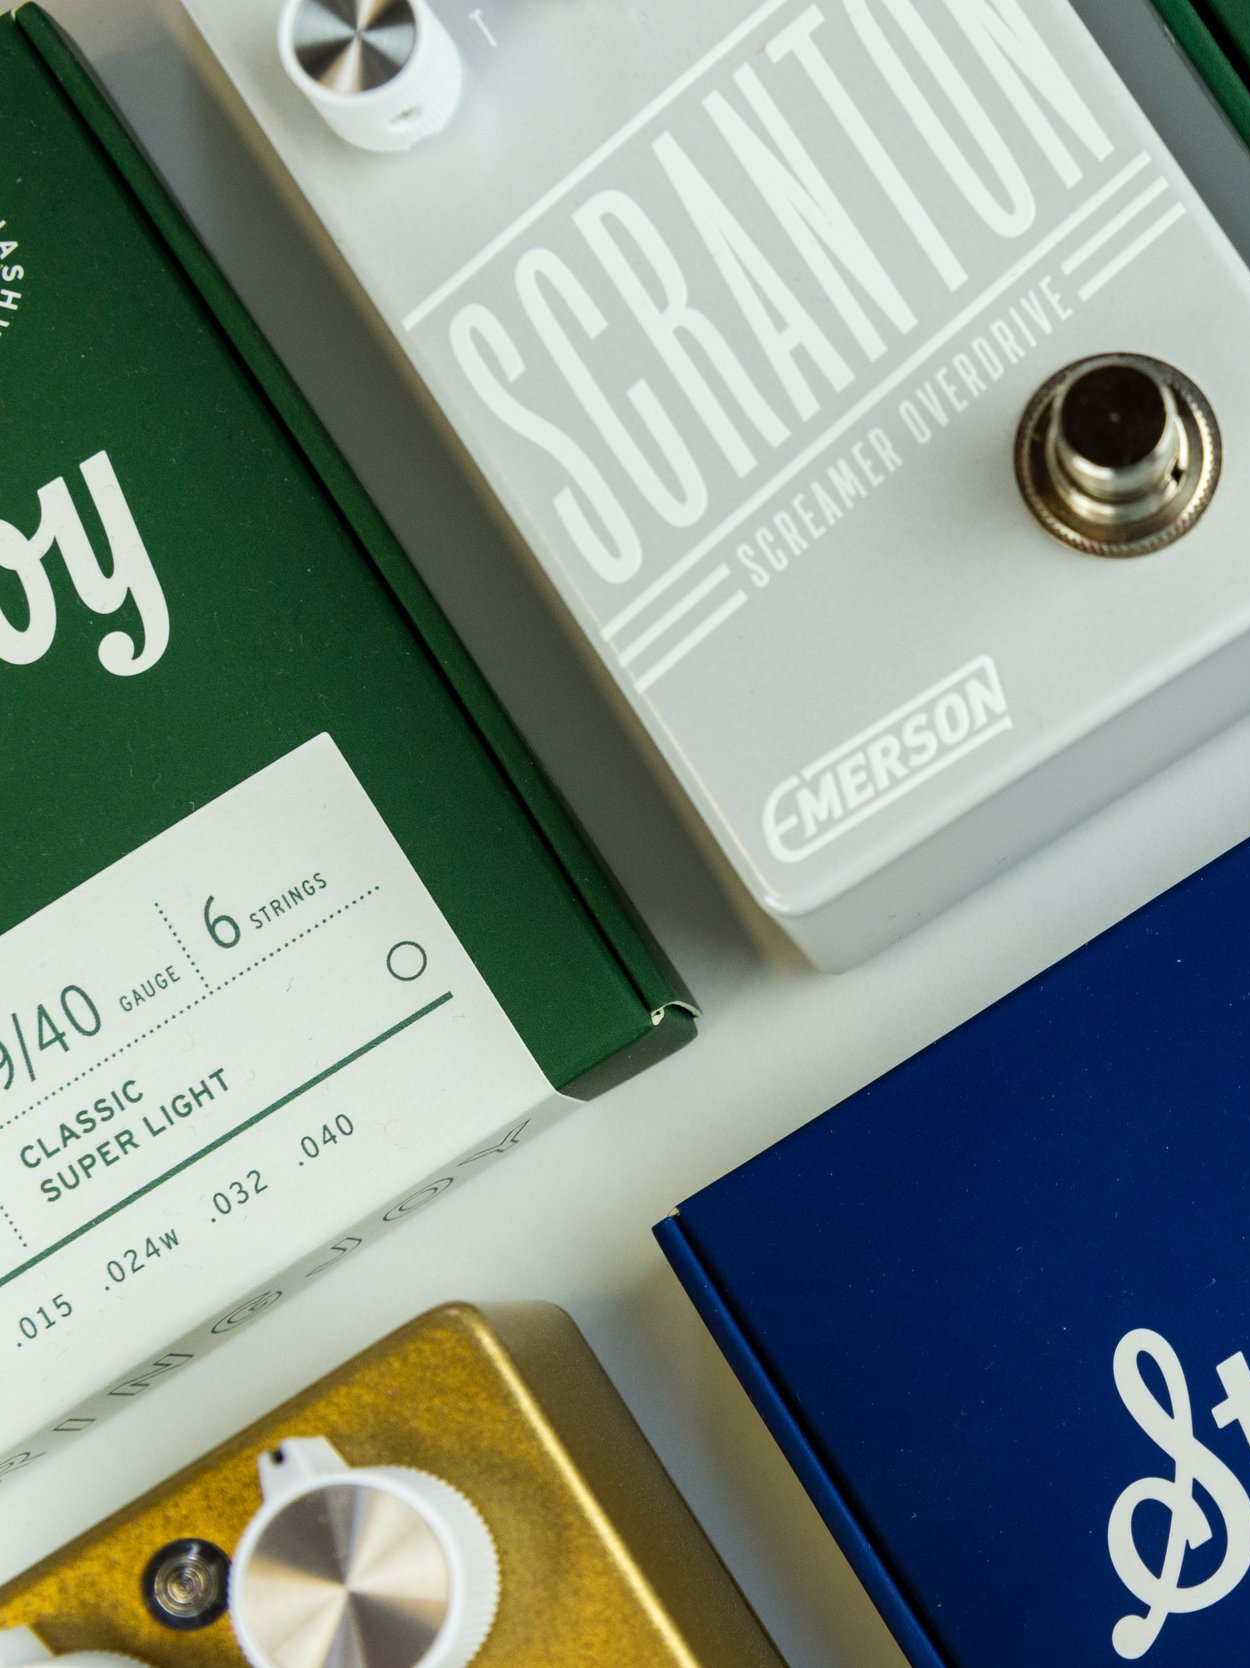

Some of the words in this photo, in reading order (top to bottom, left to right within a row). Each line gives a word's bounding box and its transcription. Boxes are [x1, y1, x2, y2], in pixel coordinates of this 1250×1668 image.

[449, 0, 1114, 585] SCRANTON
[736, 426, 903, 588] SCREAMER
[898, 275, 1074, 445] OVERDRIVE
[762, 658, 1013, 863] EMERSON
[119, 965, 182, 1013] GAUGE
[203, 896, 241, 948] 6
[249, 872, 328, 930] STRINGS
[20, 1079, 144, 1169] CLASSIC
[40, 1128, 141, 1202] SUPER
[142, 1067, 229, 1138] LIGHT
[16, 1293, 73, 1348] .015
[211, 1169, 268, 1223] .032
[298, 1113, 355, 1167] .040
